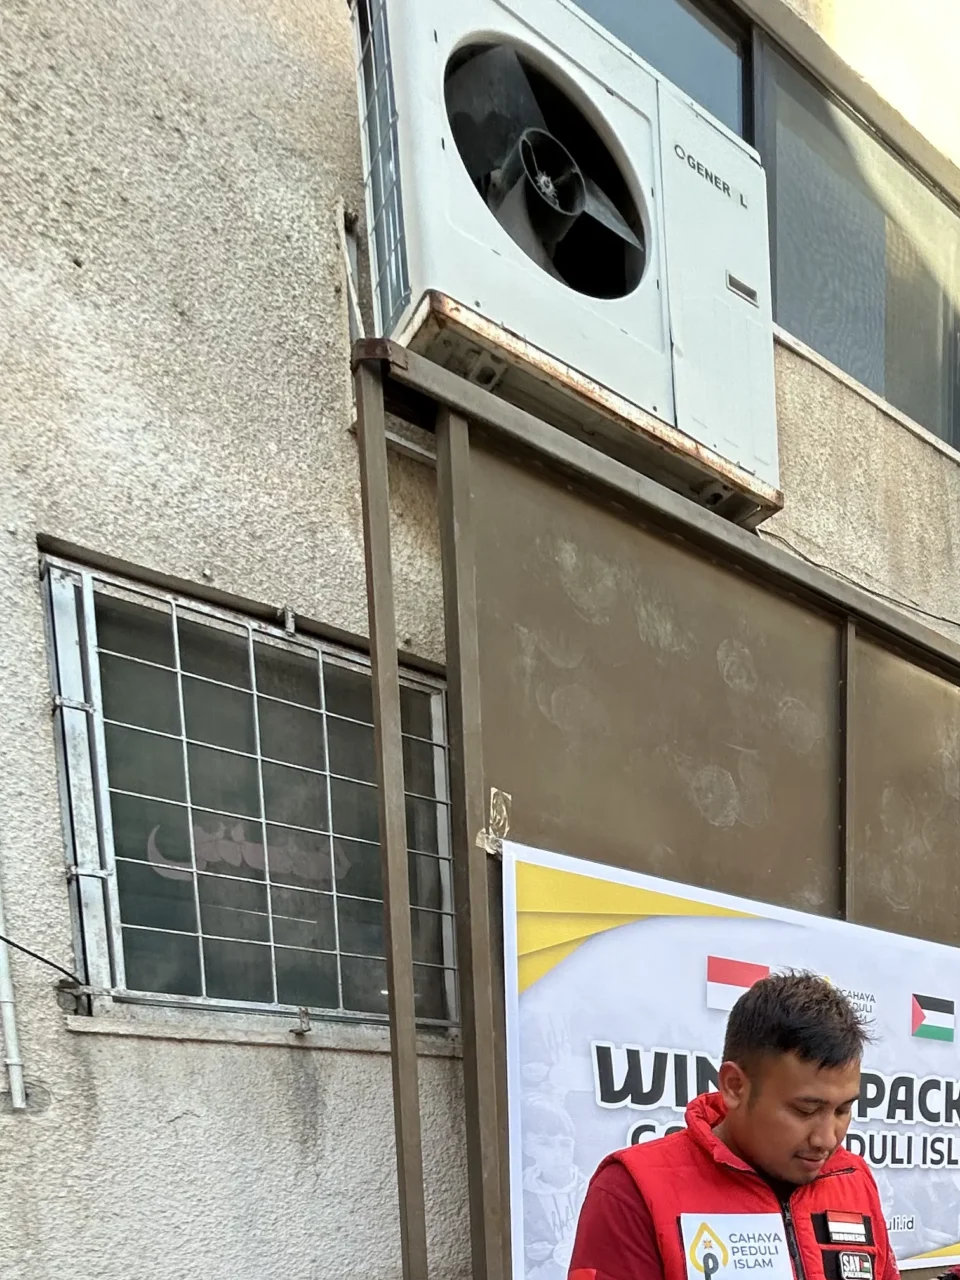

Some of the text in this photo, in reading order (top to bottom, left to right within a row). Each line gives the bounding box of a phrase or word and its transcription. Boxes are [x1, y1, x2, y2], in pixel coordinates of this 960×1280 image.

[687, 154, 748, 210] GENERL
[852, 1002, 873, 1013] DULI
[848, 1134, 912, 1165] DULI
[729, 1233, 782, 1244] CAHAYA
[731, 1245, 779, 1256] PEDULI
[733, 1258, 774, 1270] ISLAM
